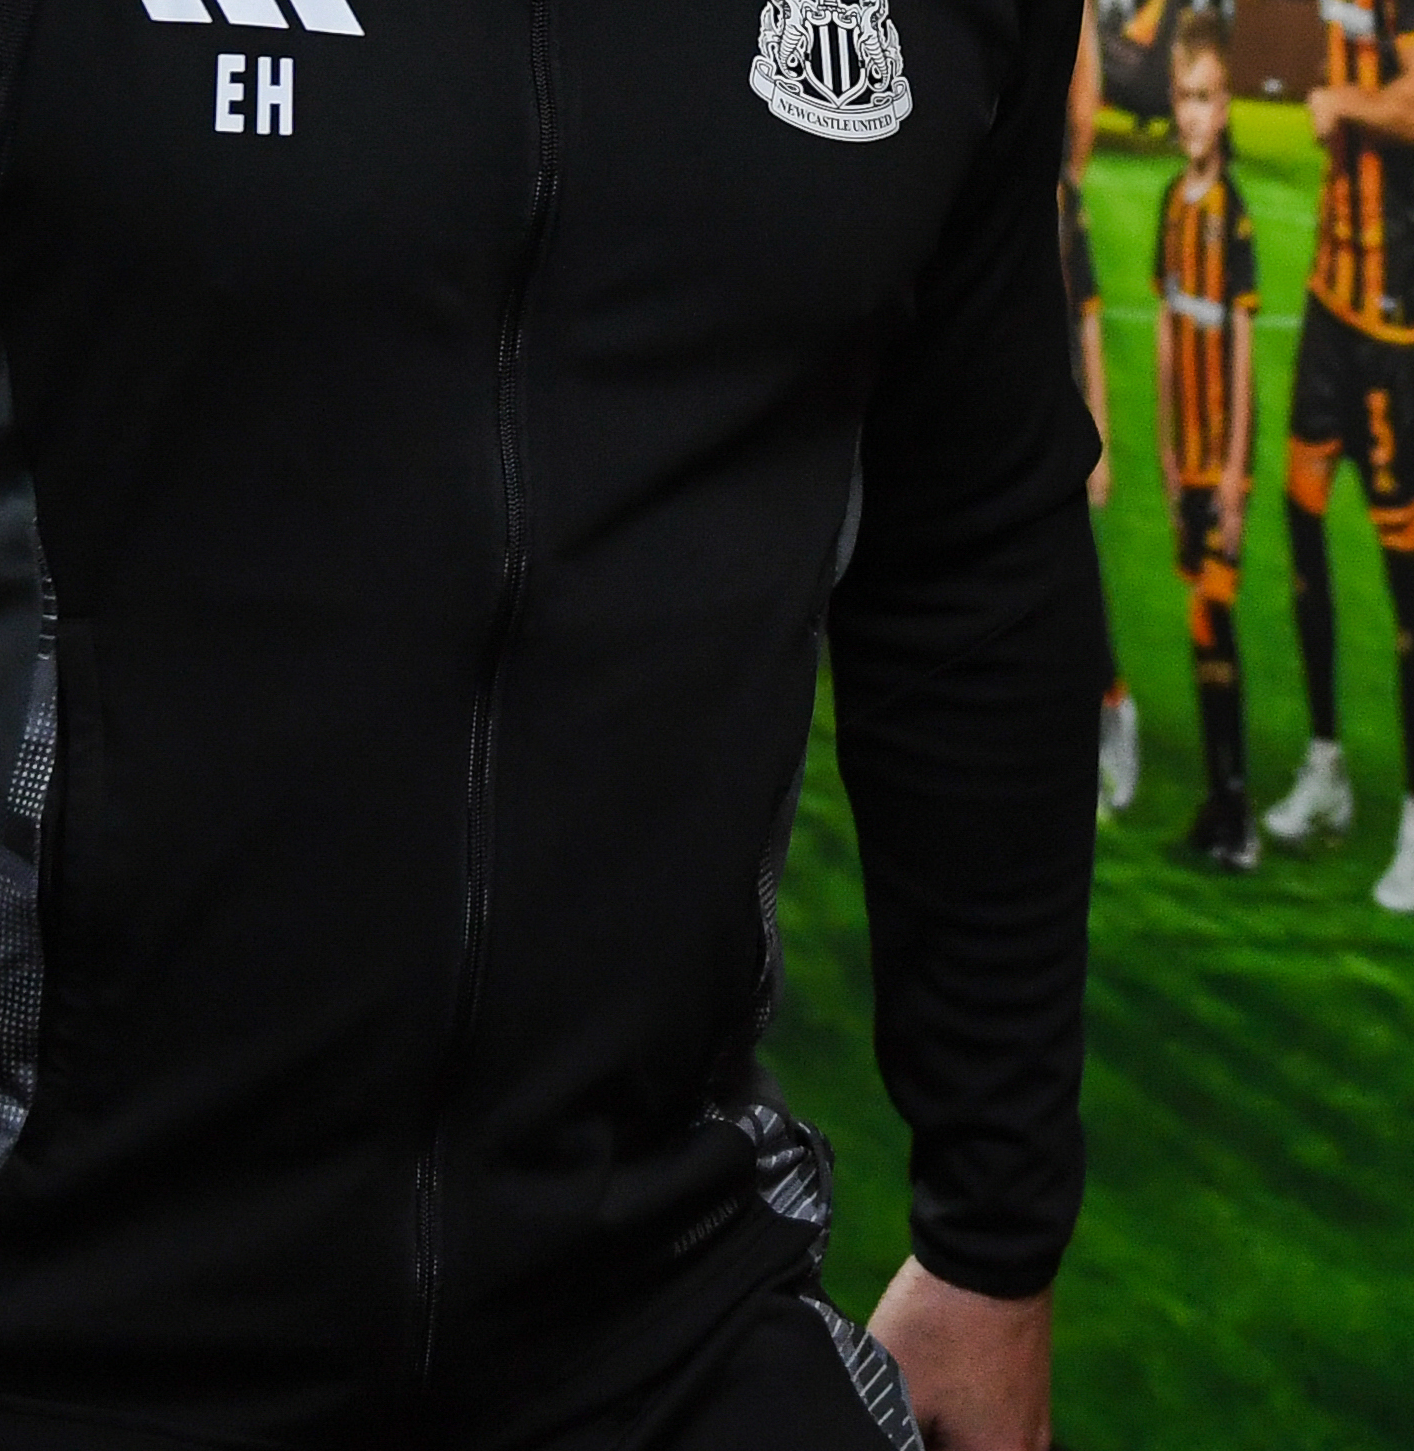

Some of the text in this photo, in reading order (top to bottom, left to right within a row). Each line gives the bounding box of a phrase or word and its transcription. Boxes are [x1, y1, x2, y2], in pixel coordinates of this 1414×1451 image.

[215, 53, 294, 136] EH
[777, 97, 893, 133] NEWCASTLE UNITED
